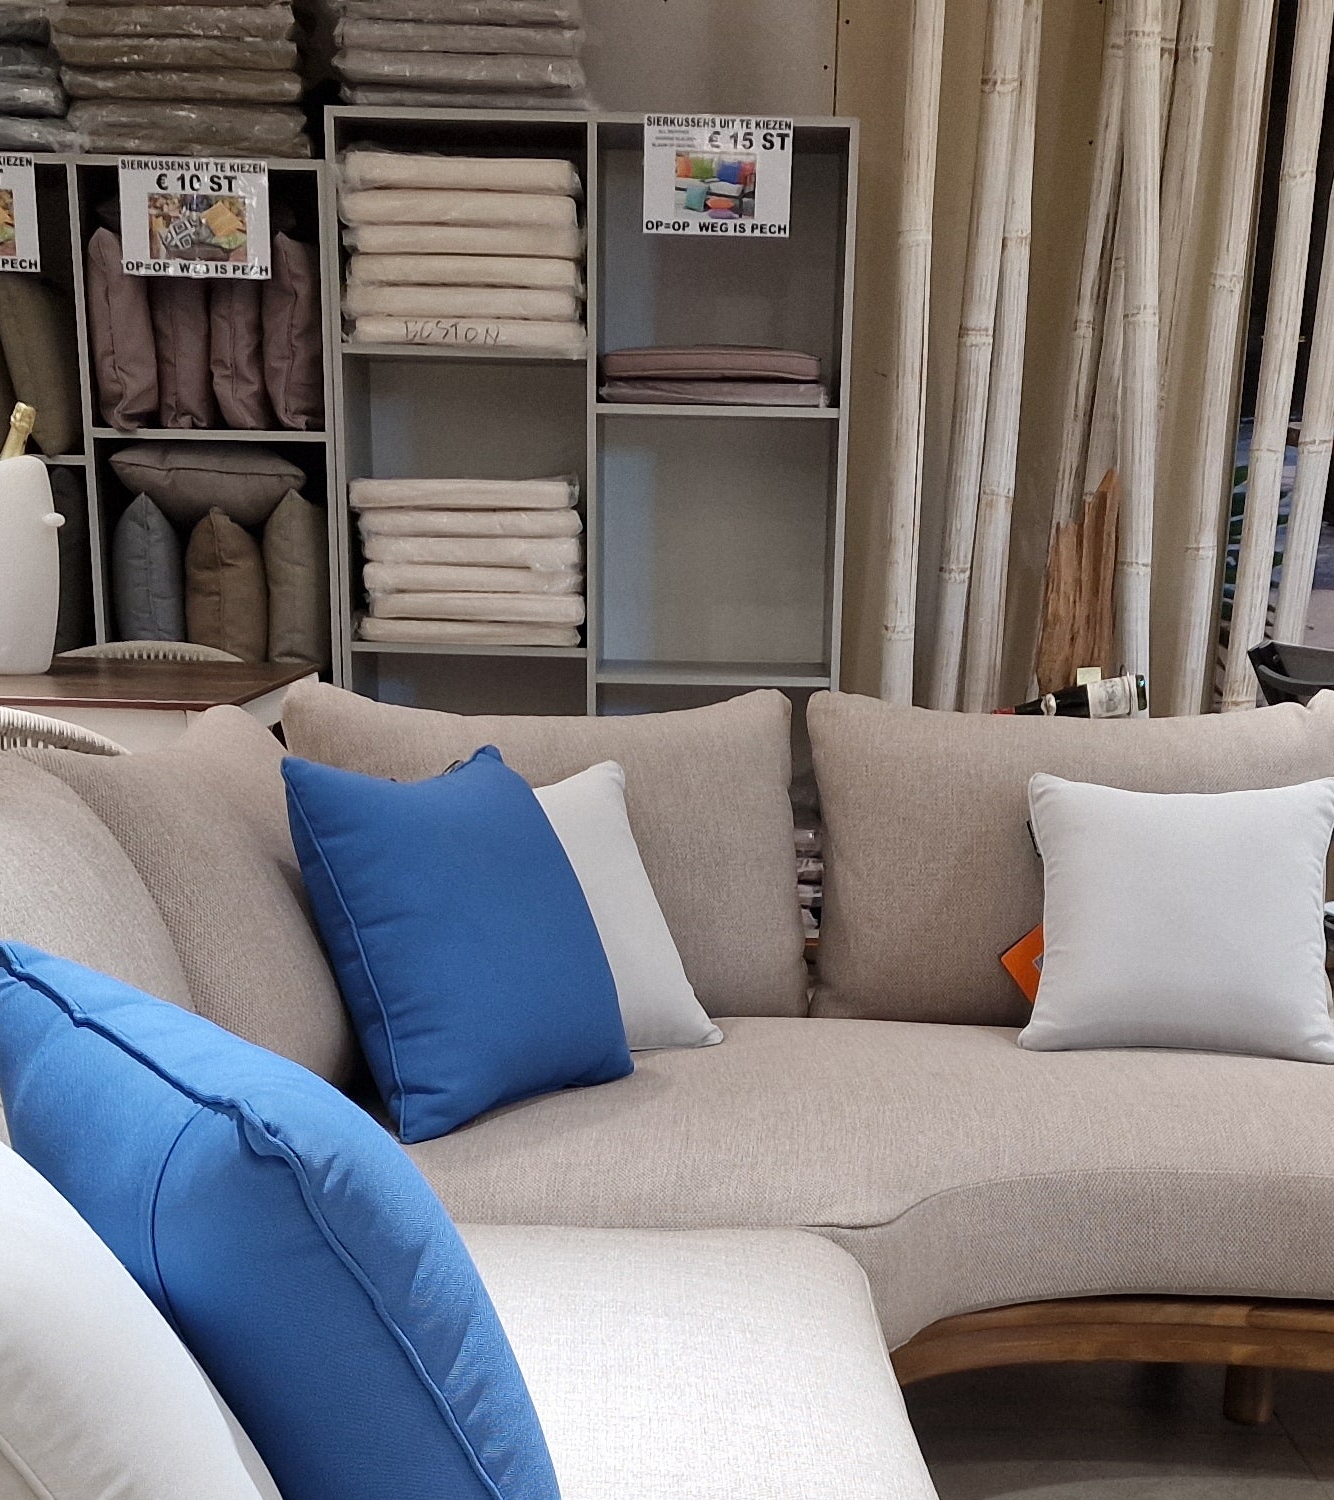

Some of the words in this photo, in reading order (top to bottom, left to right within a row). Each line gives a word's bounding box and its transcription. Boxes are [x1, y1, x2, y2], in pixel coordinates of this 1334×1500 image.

[646, 116, 716, 128] SIERKUSSENS
[719, 118, 736, 129] UIT
[739, 119, 752, 130] TE
[755, 119, 792, 131] KIEZEN
[708, 130, 721, 149] €
[729, 131, 754, 150] 15
[761, 132, 790, 151] ST
[120, 159, 191, 171] SIERKUSSENS
[193, 161, 211, 172] UIT
[215, 162, 226, 173] TE
[156, 173, 169, 191] €
[176, 173, 202, 192] 10
[209, 174, 237, 193] ST
[645, 220, 690, 231] OP=OP
[698, 221, 729, 233] WEG
[733, 222, 746, 233] IS
[750, 223, 787, 235] PECH
[1, 258, 38, 270] PECH
[214, 264, 228, 275] IS
